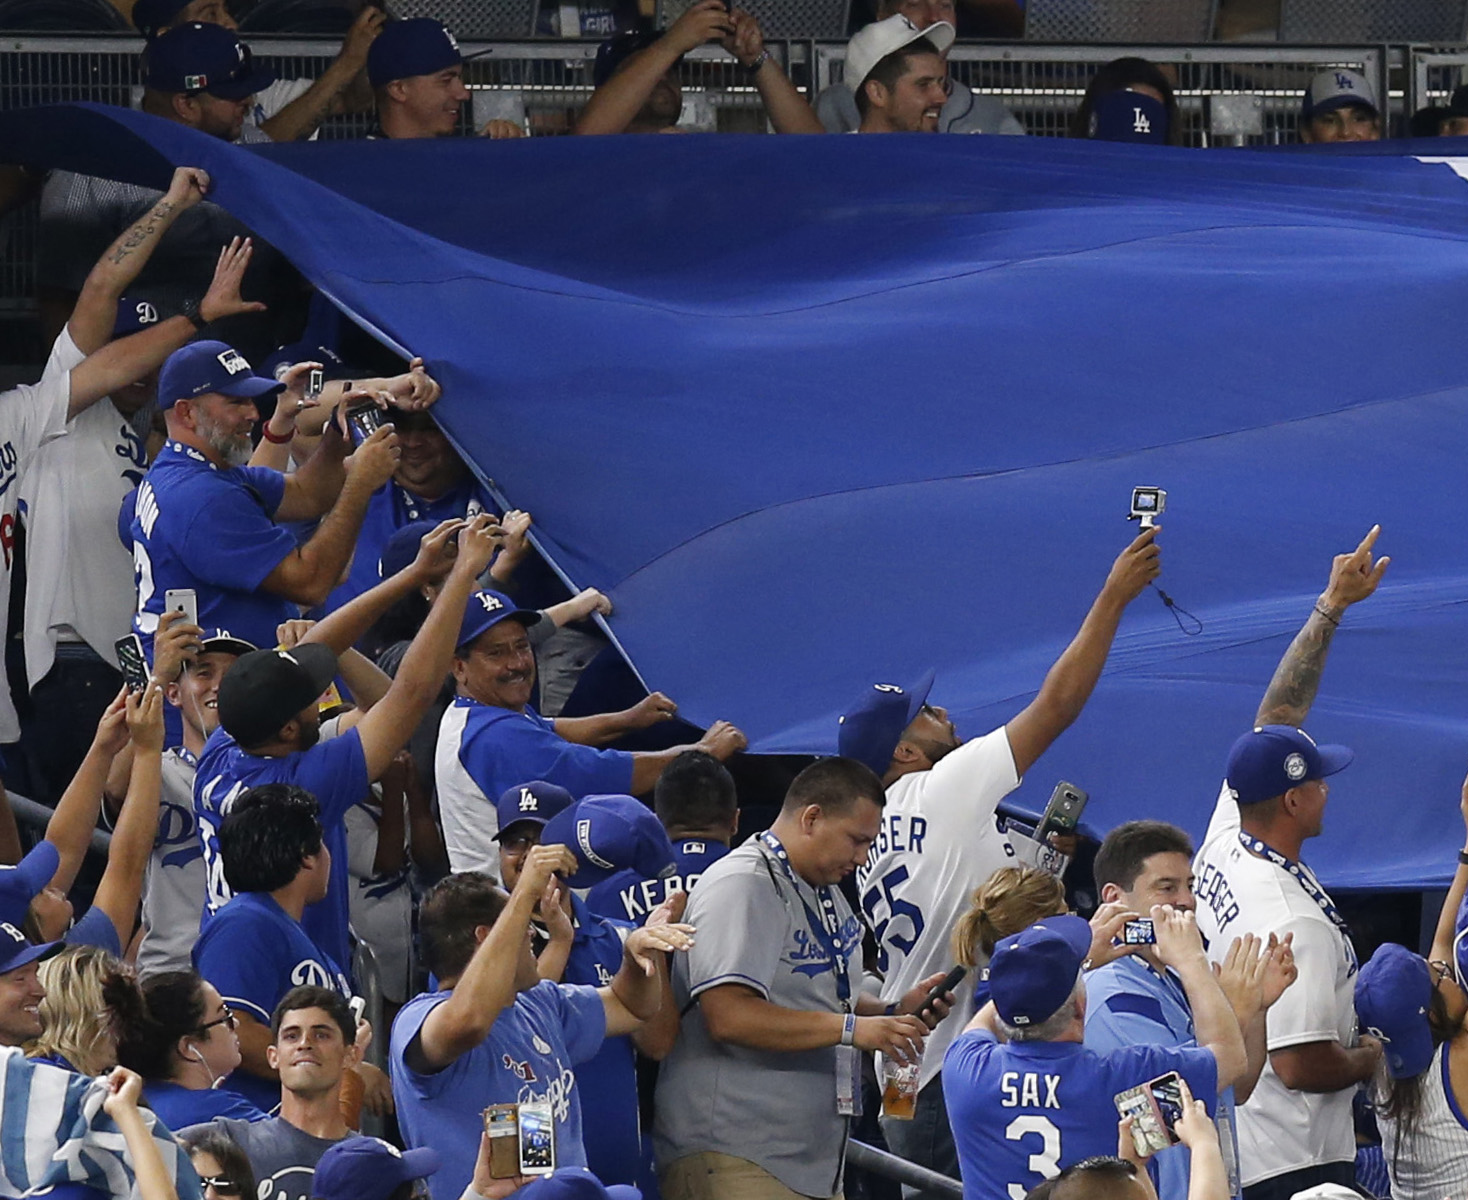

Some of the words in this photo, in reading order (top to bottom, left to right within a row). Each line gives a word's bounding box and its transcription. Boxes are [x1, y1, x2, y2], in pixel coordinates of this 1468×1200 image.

[1133, 107, 1151, 133] LA
[136, 302, 158, 324] D
[475, 591, 503, 612] LA
[519, 788, 538, 812] LA
[863, 864, 926, 971] 55
[594, 964, 615, 986] LA
[1001, 1072, 1061, 1110] SAX
